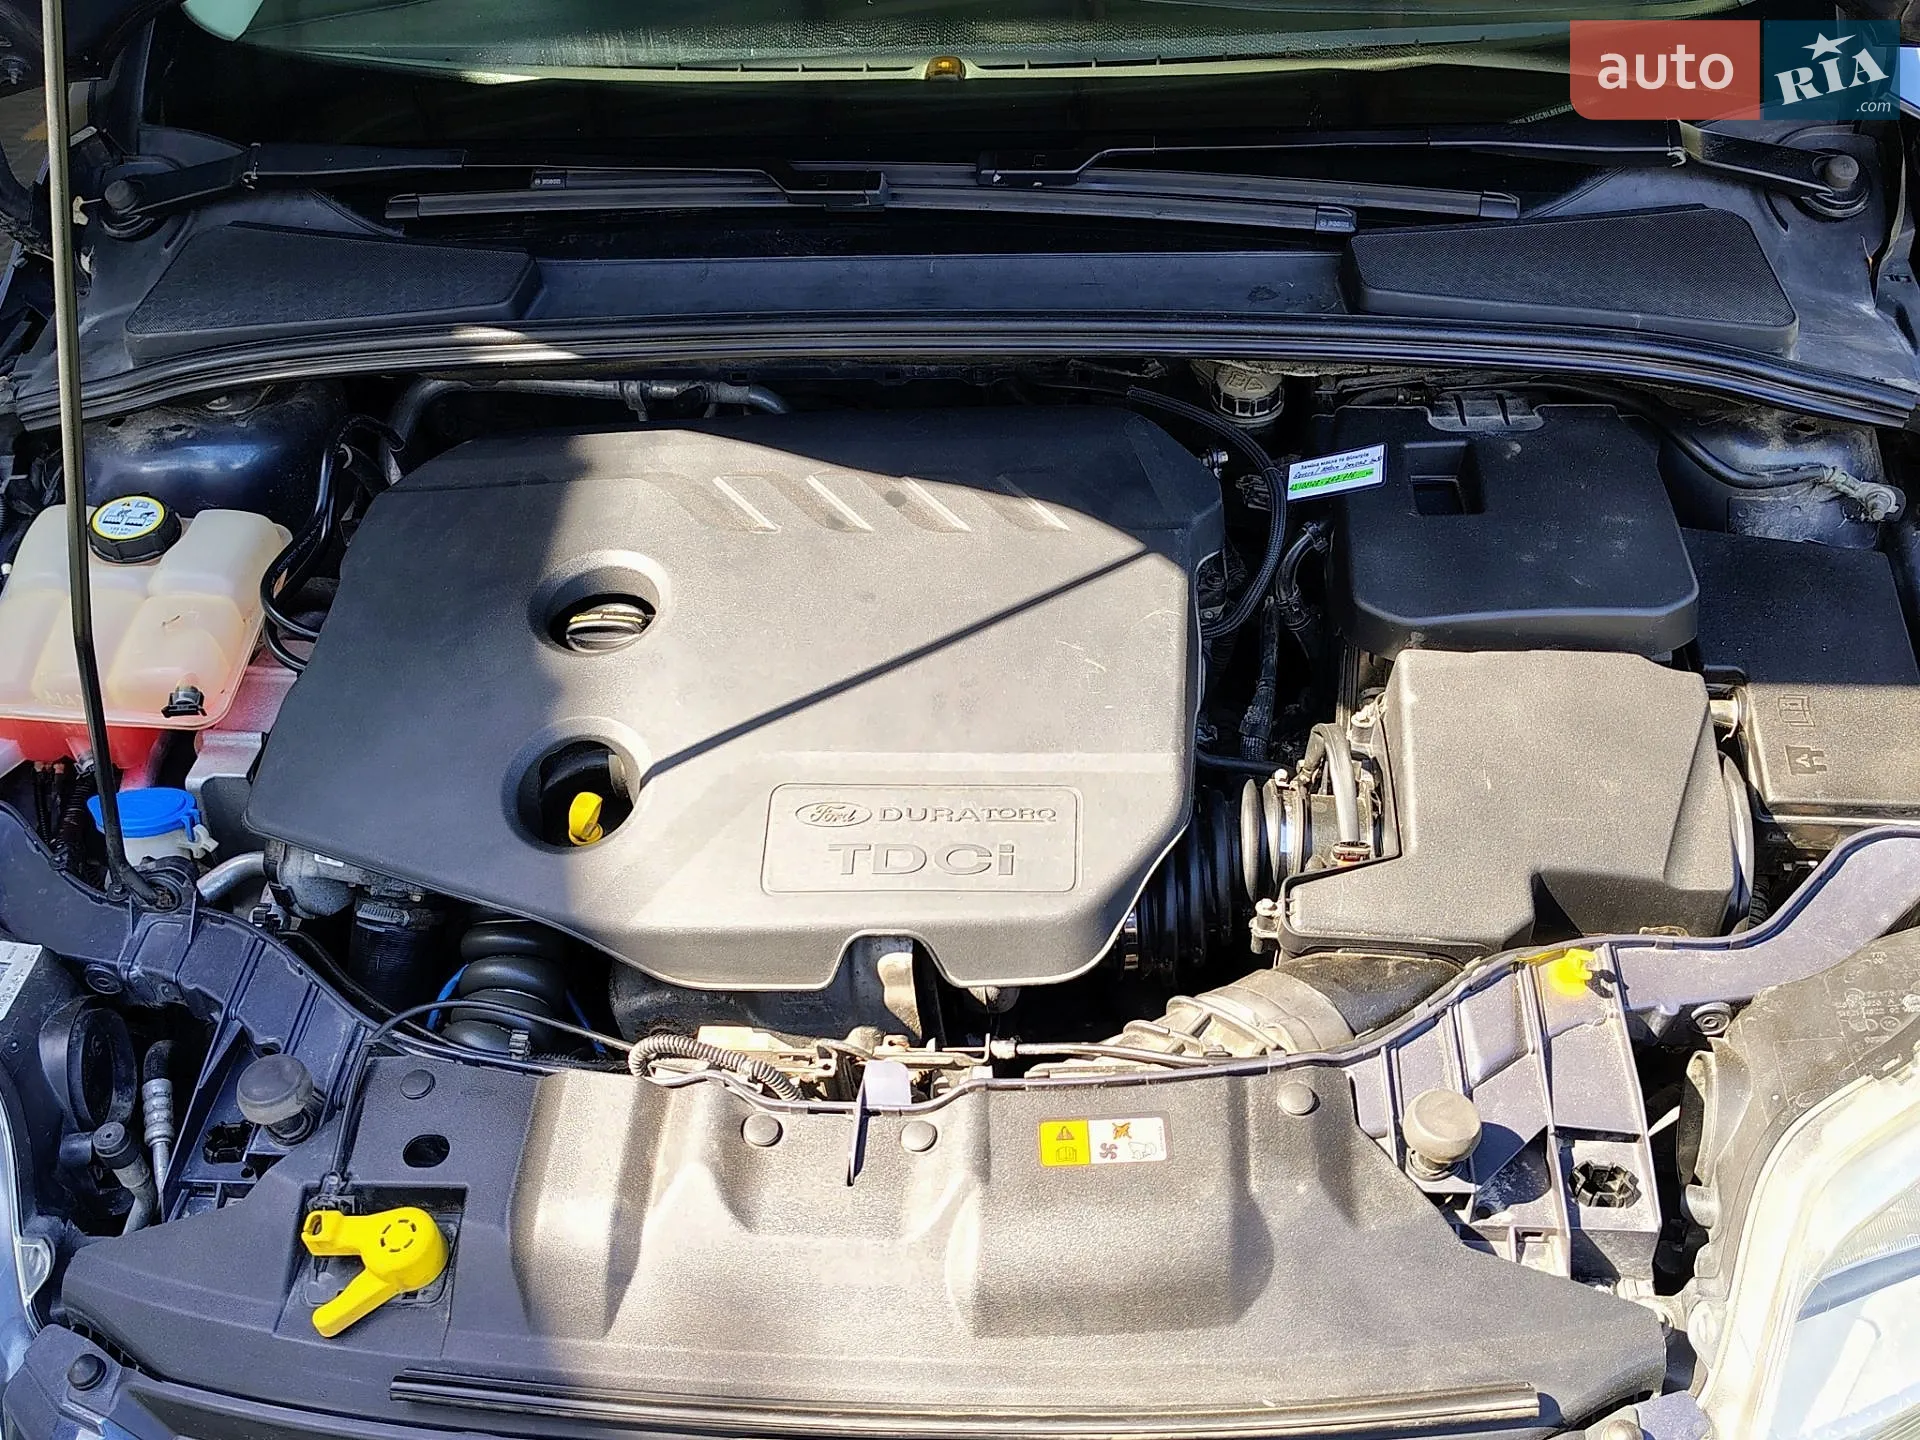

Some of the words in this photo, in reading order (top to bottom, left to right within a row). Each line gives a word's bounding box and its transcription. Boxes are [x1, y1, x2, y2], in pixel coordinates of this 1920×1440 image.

[810, 804, 857, 823] Ford
[879, 807, 1057, 822] DURATORQ
[828, 843, 1016, 876] TDCi
